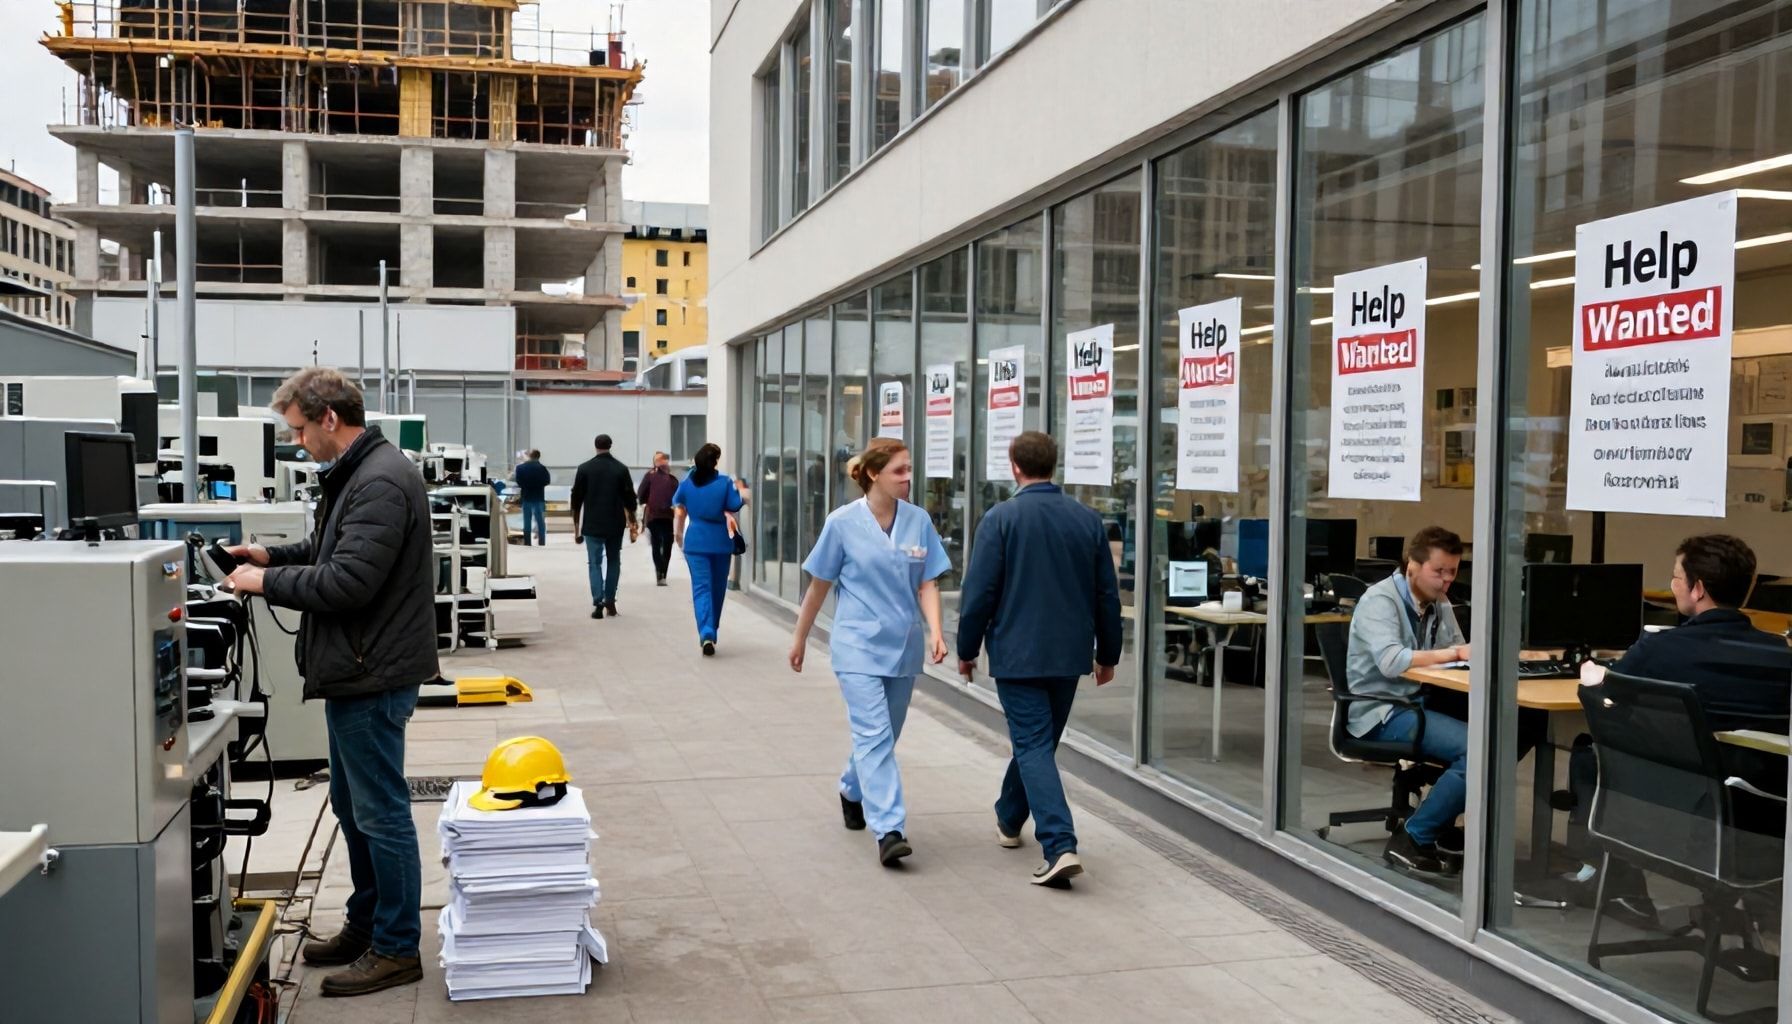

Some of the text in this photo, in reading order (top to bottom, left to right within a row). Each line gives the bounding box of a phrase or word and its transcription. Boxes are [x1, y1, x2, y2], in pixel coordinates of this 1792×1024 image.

[1605, 230, 1698, 289] Help
[1351, 284, 1405, 329] Help
[1588, 289, 1714, 343] Wanted
[1191, 317, 1227, 355] Help
[1341, 330, 1412, 369] Wanted
